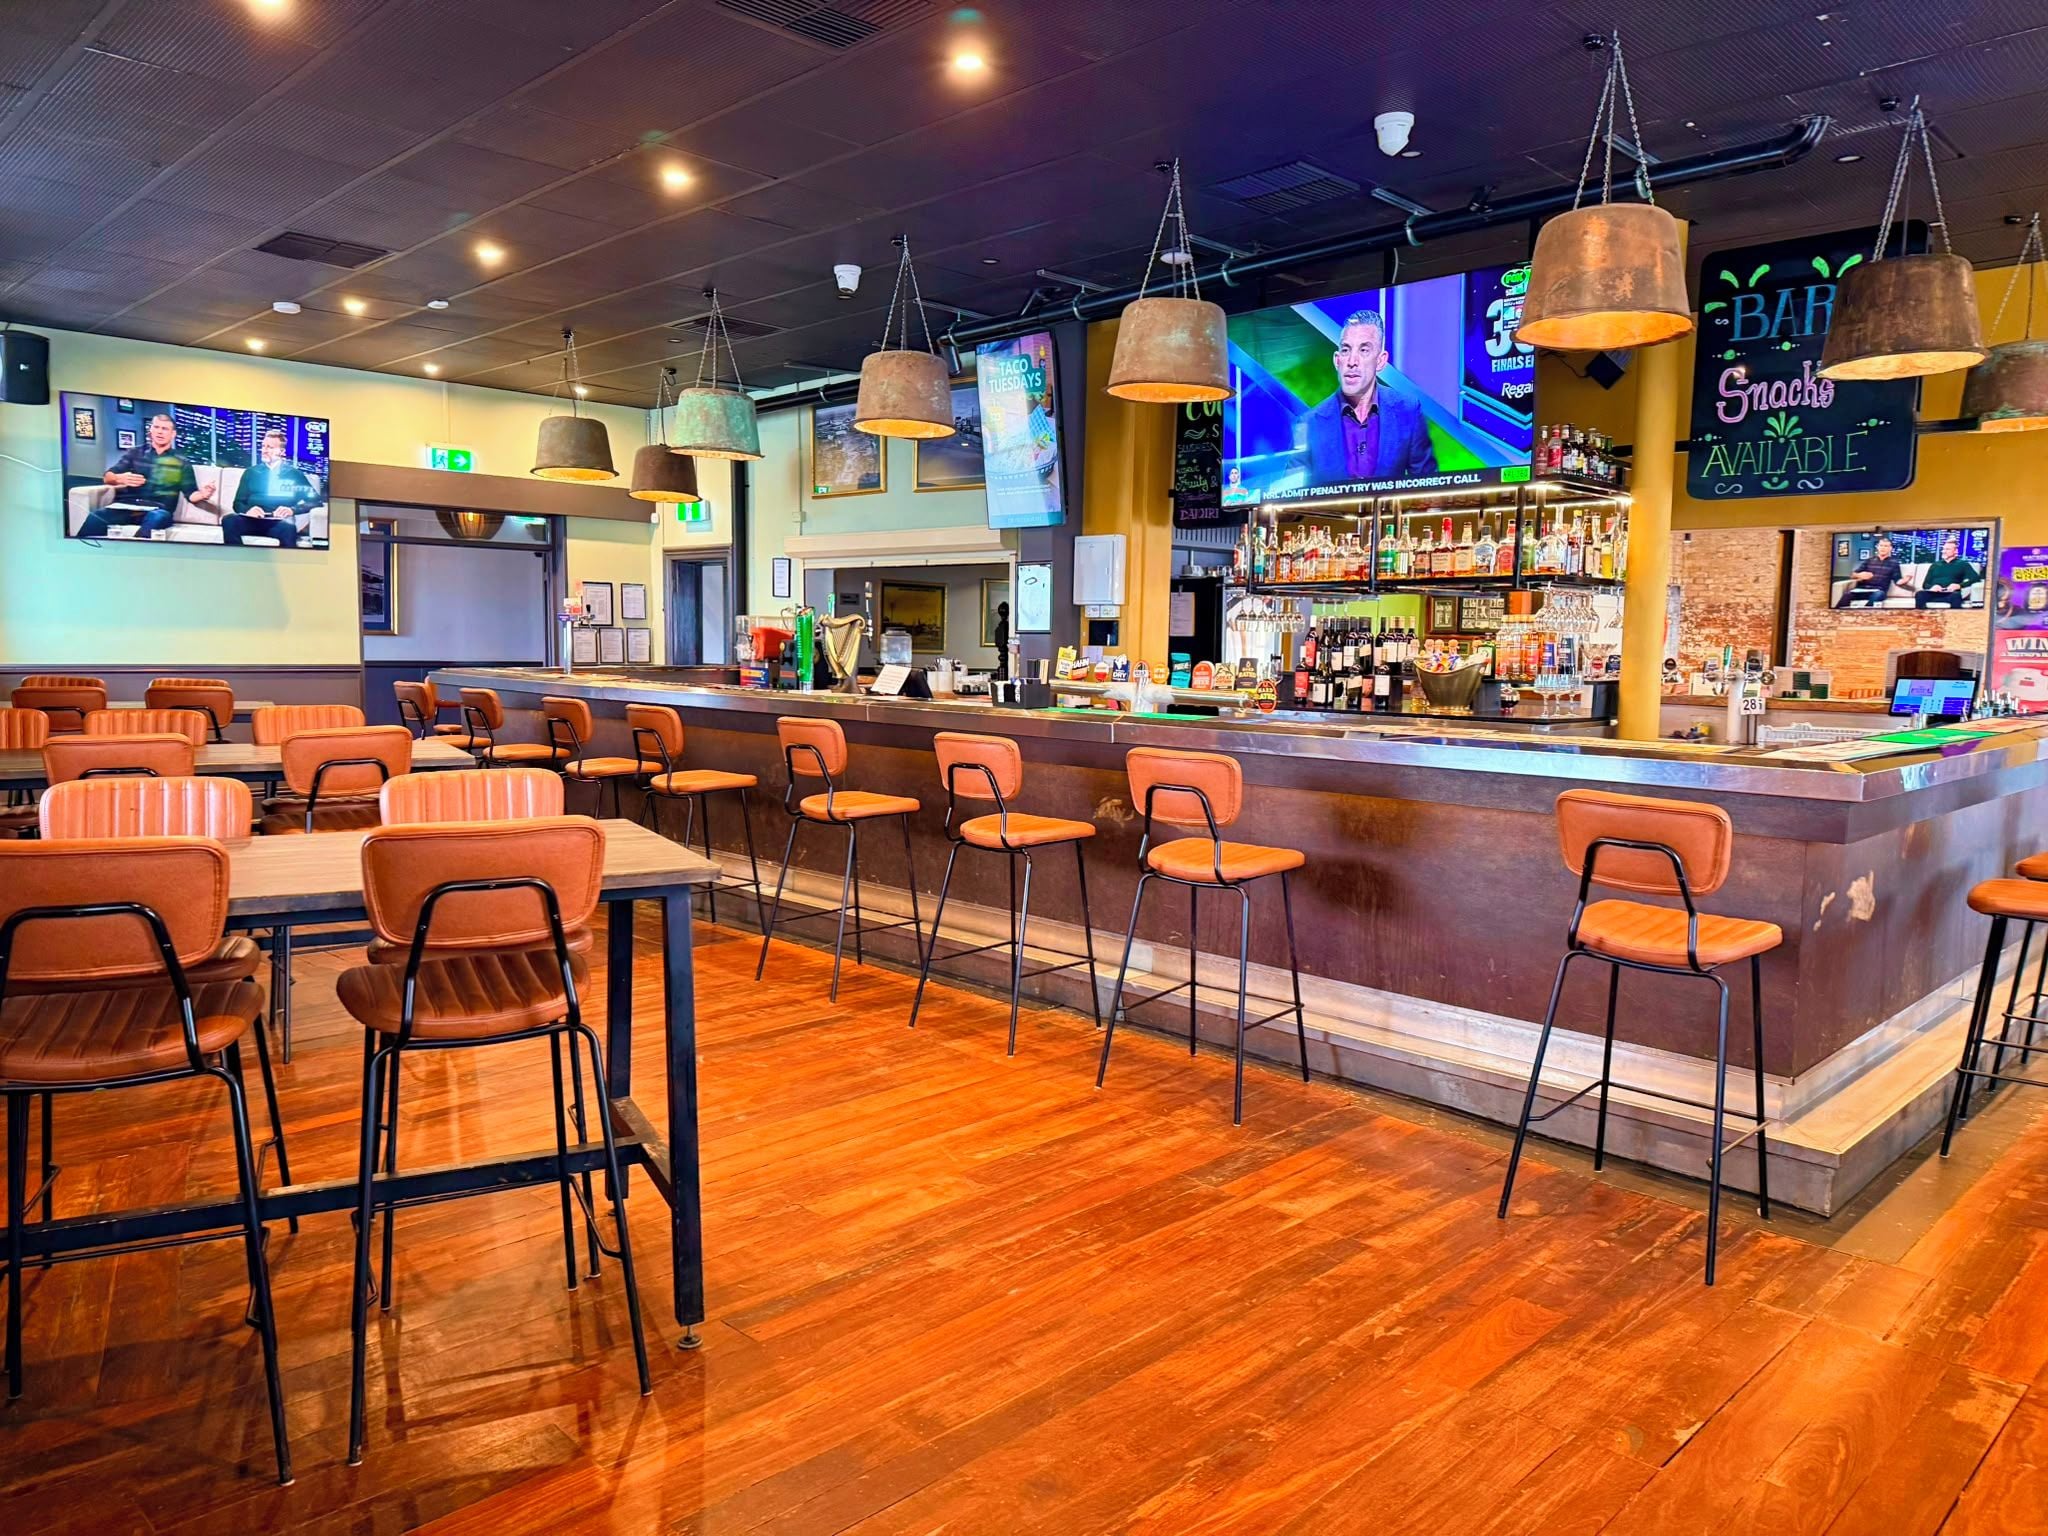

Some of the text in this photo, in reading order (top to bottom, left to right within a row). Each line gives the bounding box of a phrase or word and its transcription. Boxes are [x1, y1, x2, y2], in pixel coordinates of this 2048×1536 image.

[1729, 283, 1838, 342] BAR
[999, 358, 1029, 377] TACO
[1491, 355, 1525, 373] FINALS
[987, 372, 1042, 394] TUESDAYS
[1715, 360, 1836, 424] Snacks
[1701, 431, 1868, 478] AVAILABLE
[1263, 474, 1482, 500] NRL ADMIT PENALTY TRY WAS INCORRECT CALL
